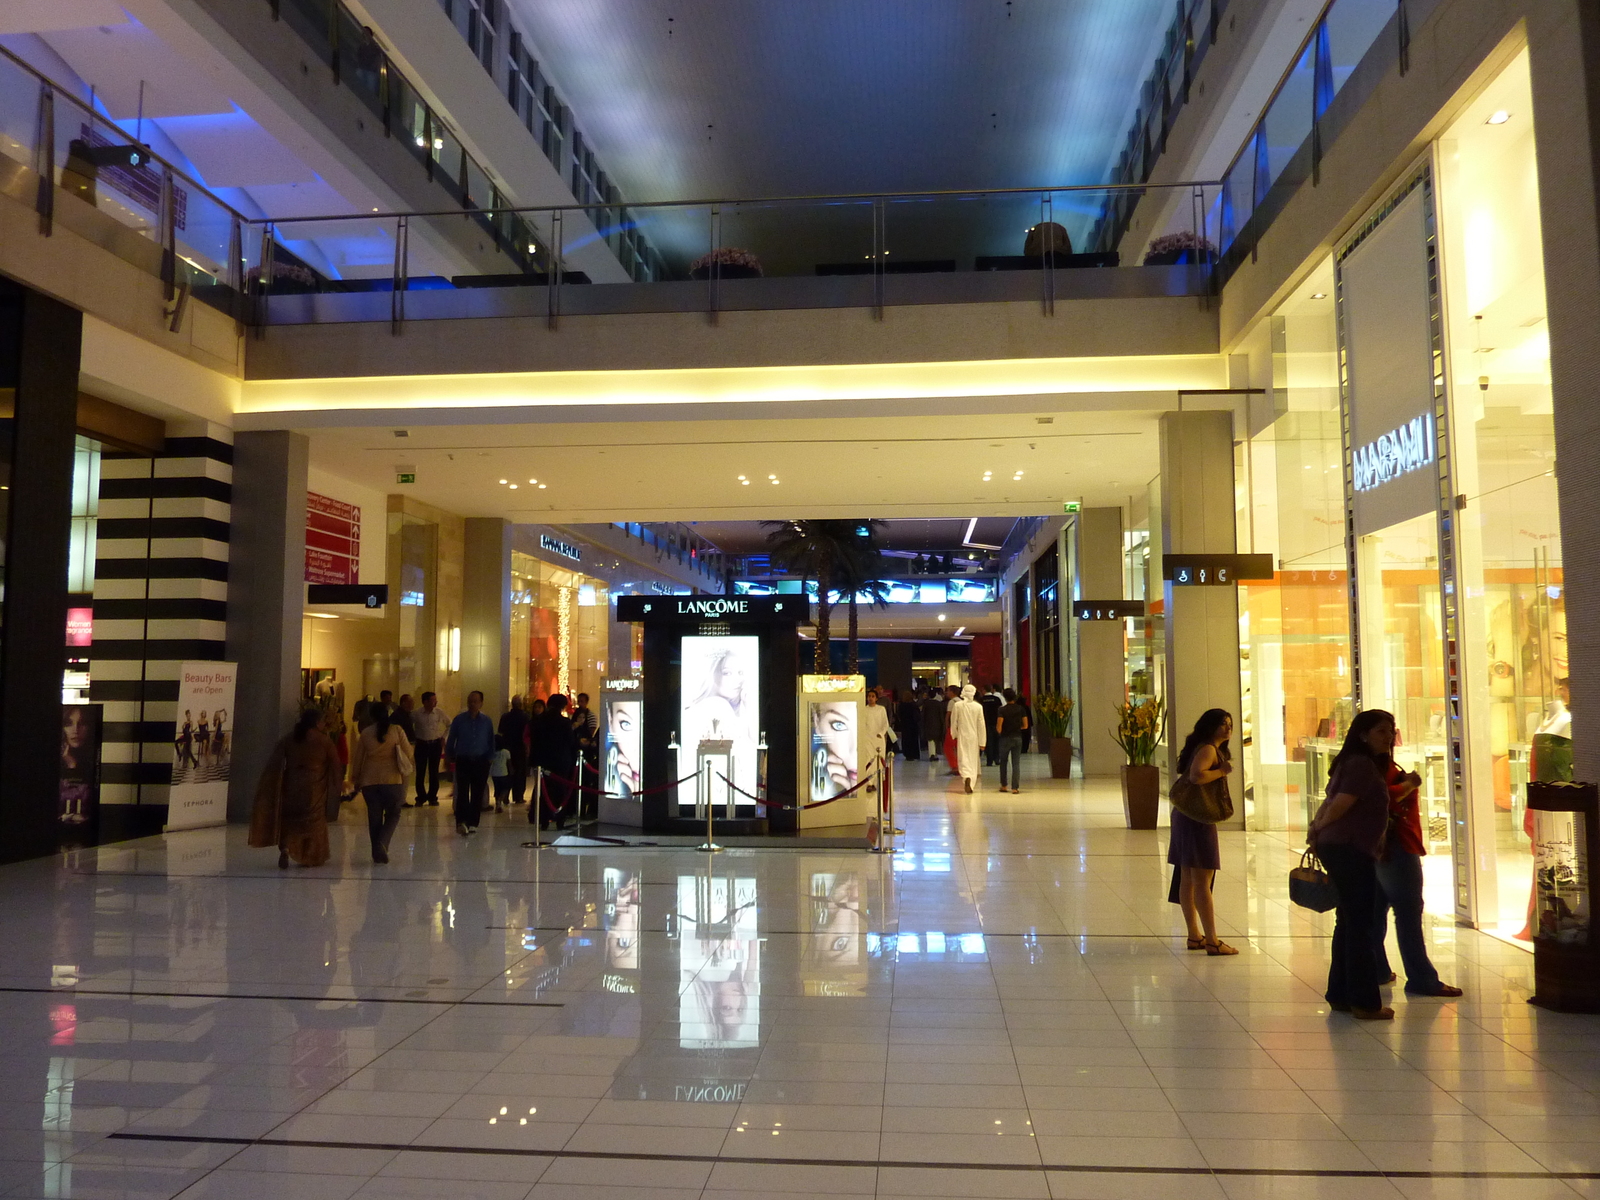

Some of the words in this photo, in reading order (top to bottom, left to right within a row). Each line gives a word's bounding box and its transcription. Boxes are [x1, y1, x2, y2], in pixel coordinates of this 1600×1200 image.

[677, 599, 749, 613] LANCÔME
[184, 672, 213, 685] Beauty
[215, 673, 232, 683] Bars
[205, 686, 223, 696] Open
[183, 799, 214, 808] SEPHORA
